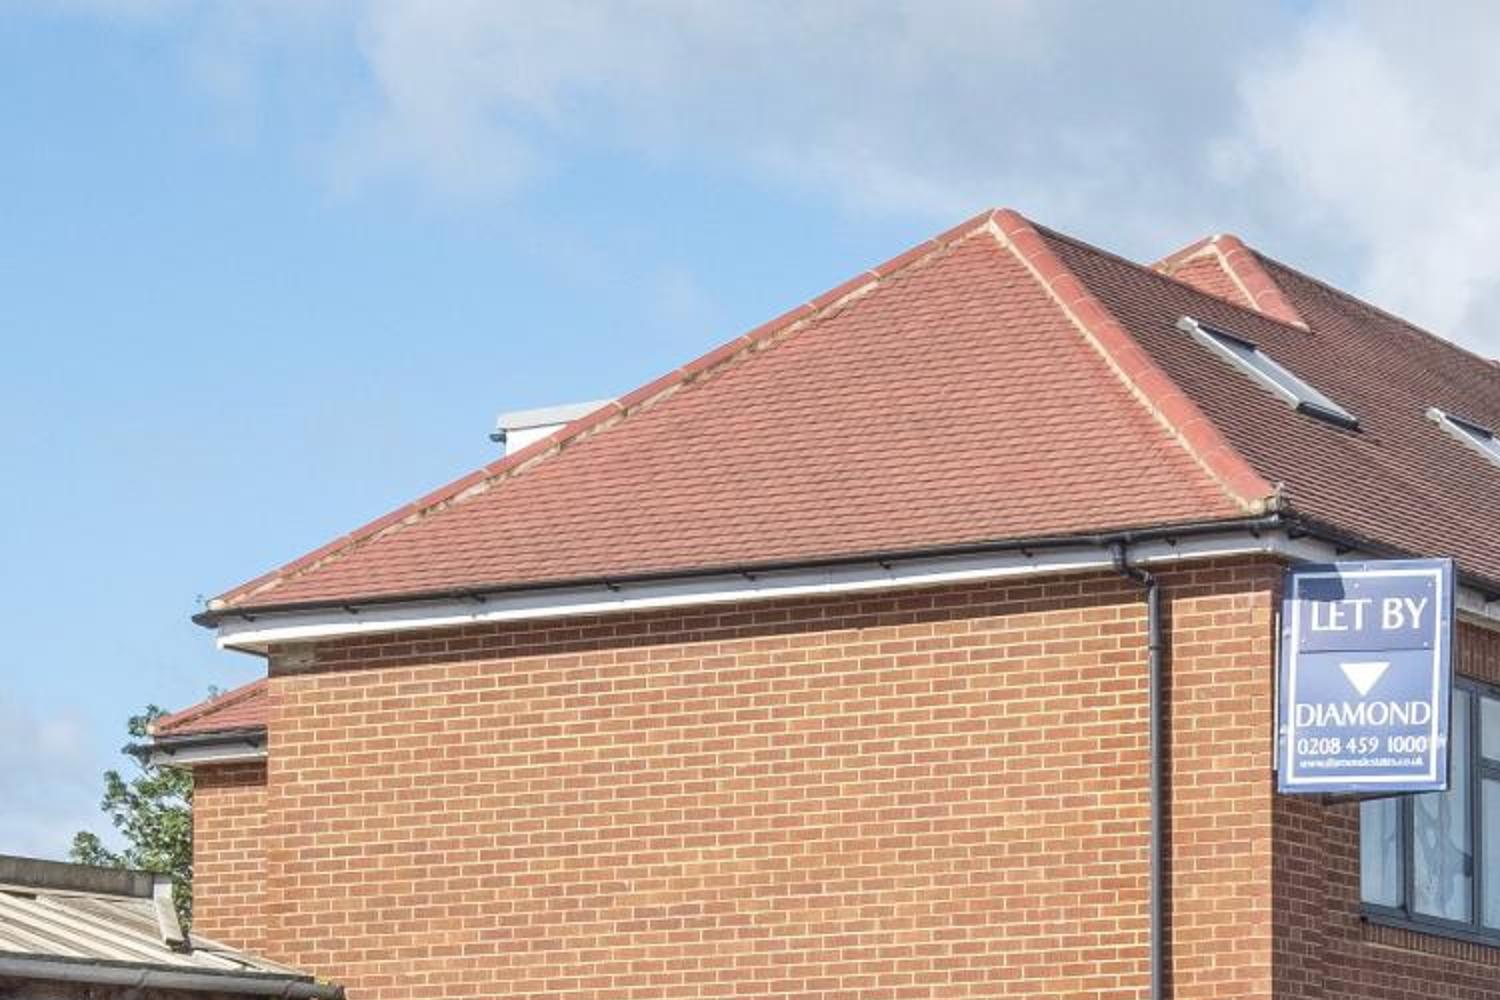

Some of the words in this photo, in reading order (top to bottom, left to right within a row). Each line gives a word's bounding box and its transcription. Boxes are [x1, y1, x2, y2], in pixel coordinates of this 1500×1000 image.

[1311, 598, 1373, 631] LET
[1381, 597, 1428, 630] BY
[1295, 701, 1432, 728] DIAMOND
[1297, 737, 1342, 756] 0208
[1346, 736, 1379, 754] 459
[1387, 735, 1428, 754] 1000
